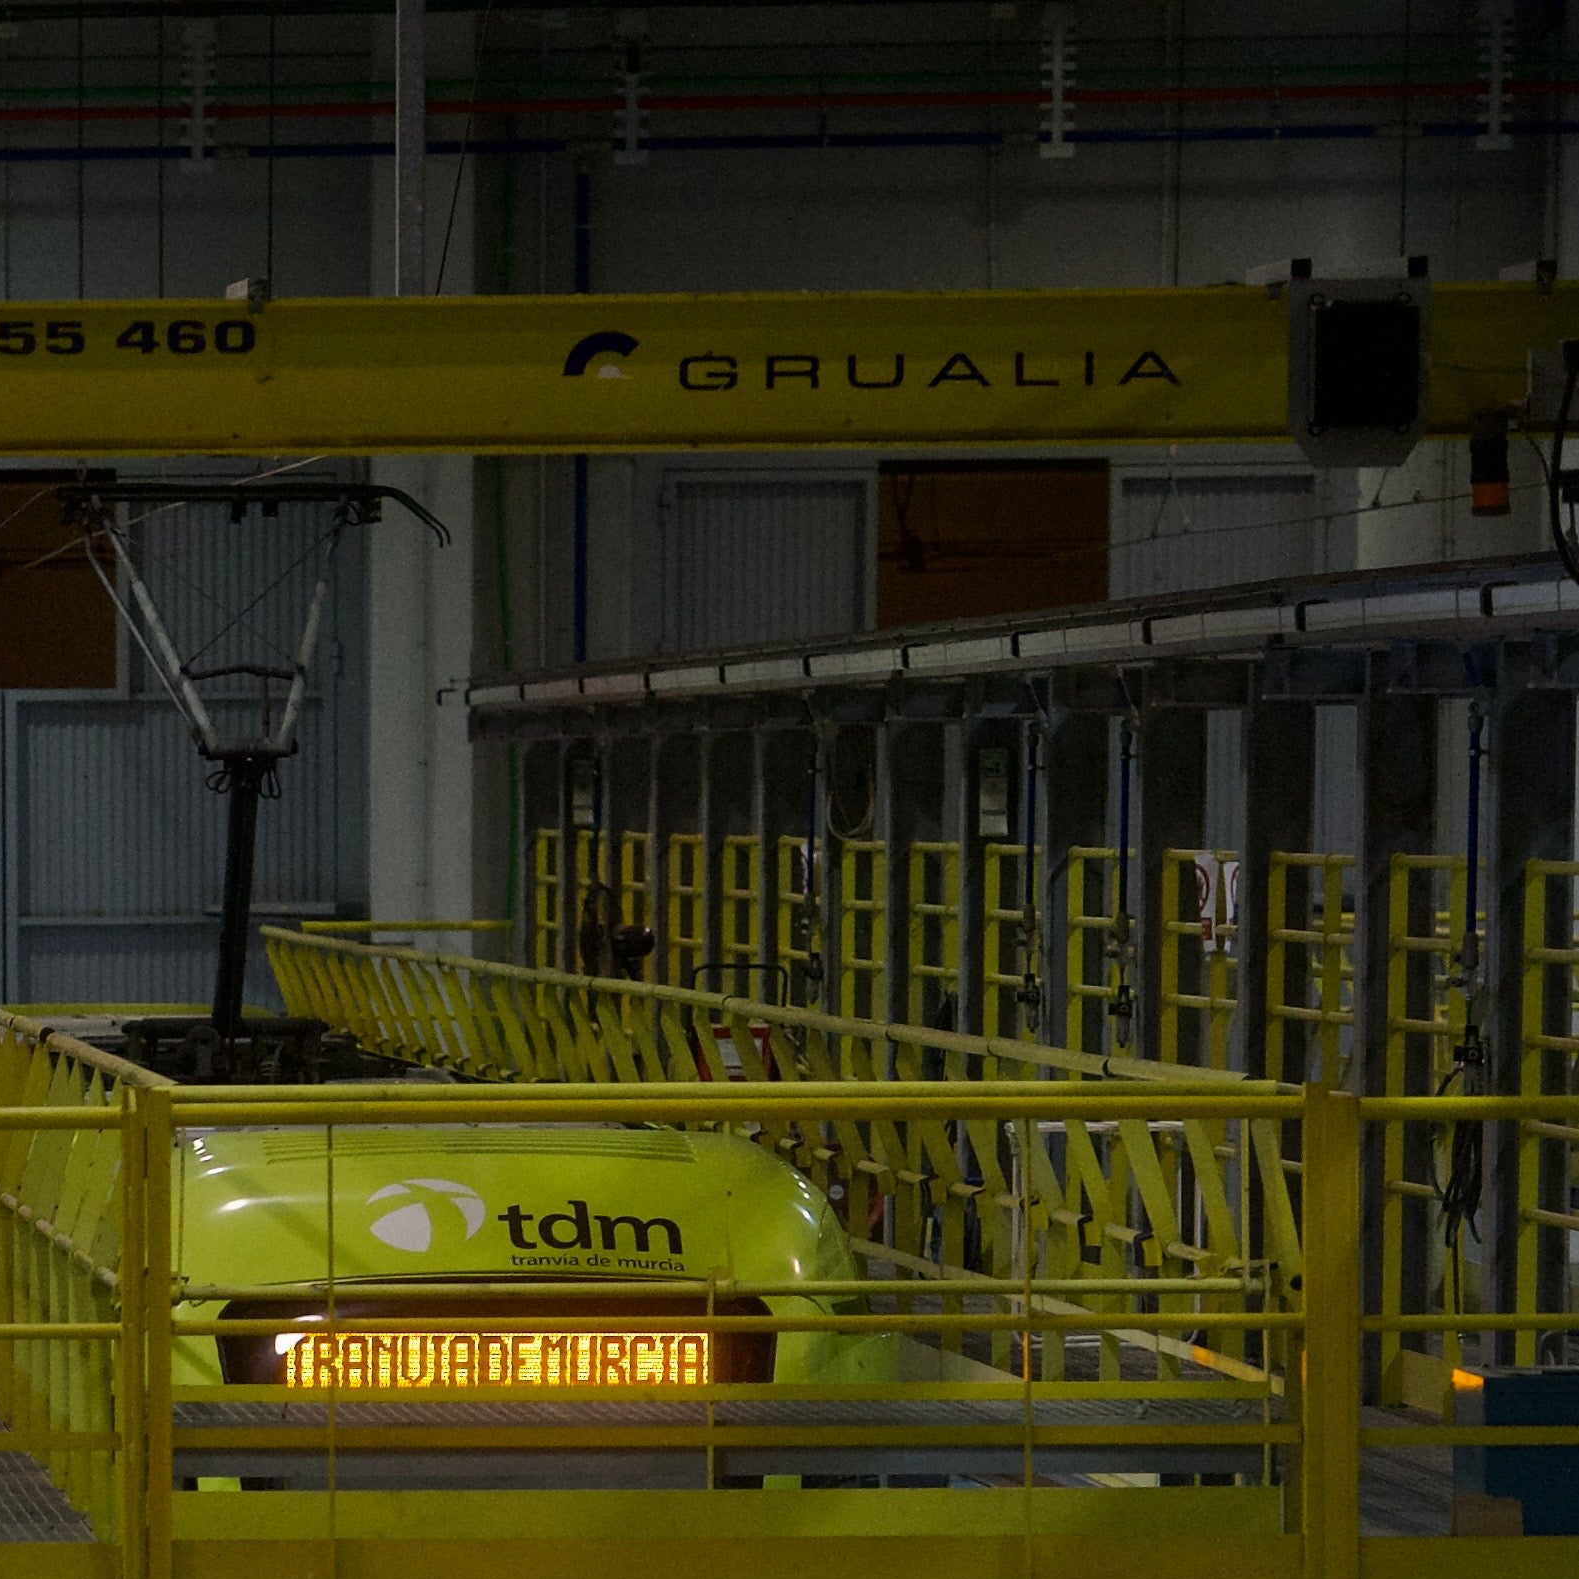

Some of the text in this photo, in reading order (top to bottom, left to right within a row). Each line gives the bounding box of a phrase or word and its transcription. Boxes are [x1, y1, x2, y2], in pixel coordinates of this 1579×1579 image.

[117, 320, 257, 354] 460
[678, 350, 1182, 392] GRUALIA
[497, 1200, 683, 1255] tdm
[511, 1251, 685, 1272] tranvía de murcia
